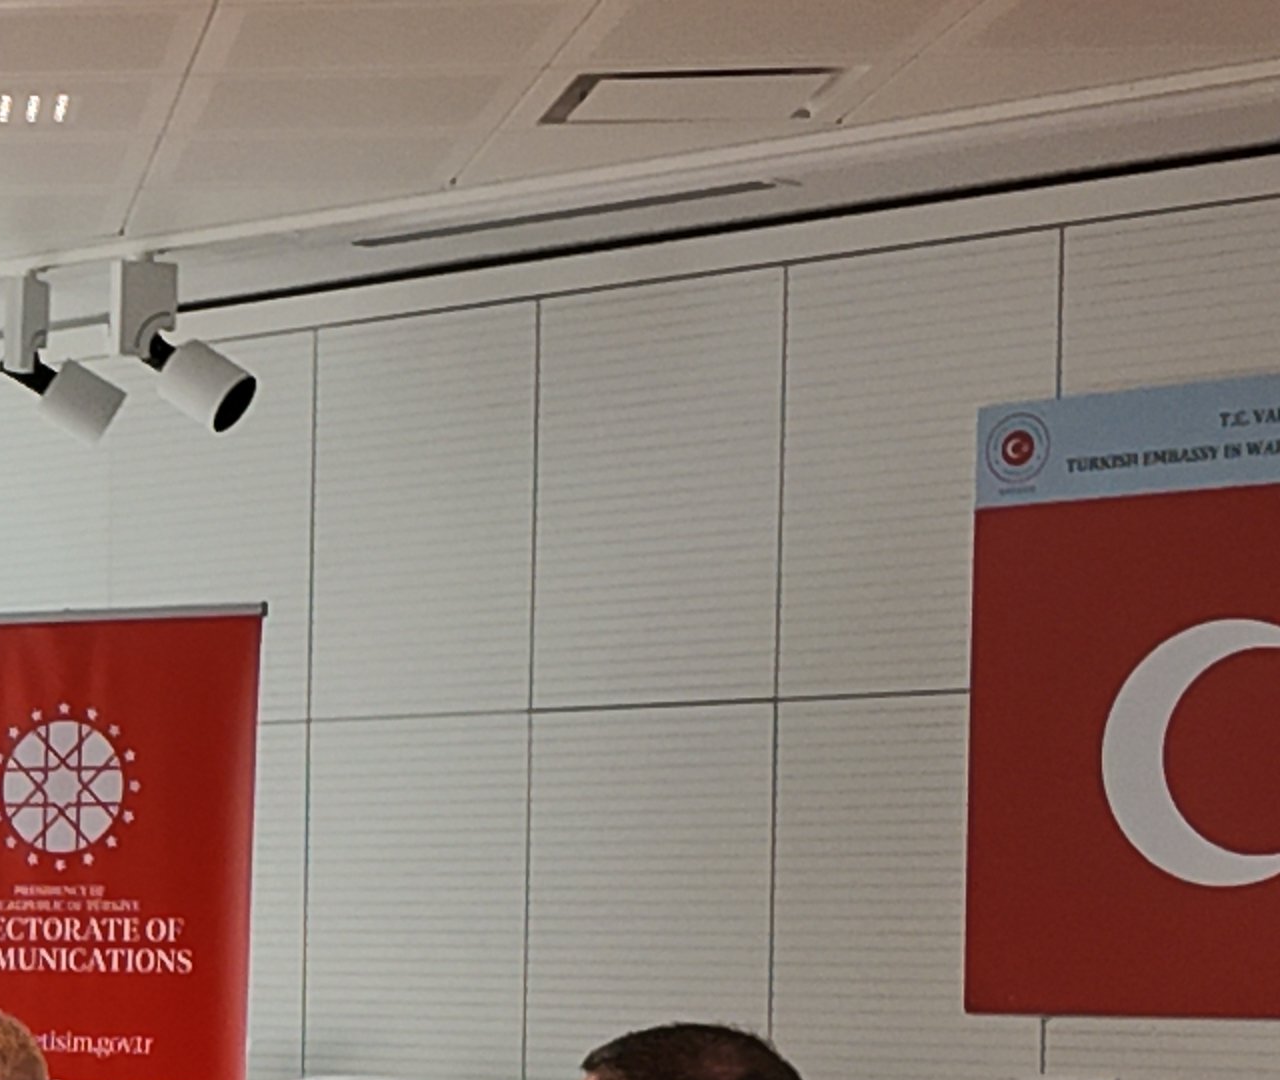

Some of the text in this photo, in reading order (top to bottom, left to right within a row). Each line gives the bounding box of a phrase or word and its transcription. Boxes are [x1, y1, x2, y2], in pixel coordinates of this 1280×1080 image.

[1252, 407, 1280, 424] VA
[1066, 452, 1138, 473] TURKISH
[1143, 445, 1217, 466] EMBASSY
[1223, 442, 1242, 459] IN
[145, 918, 186, 943] OF
